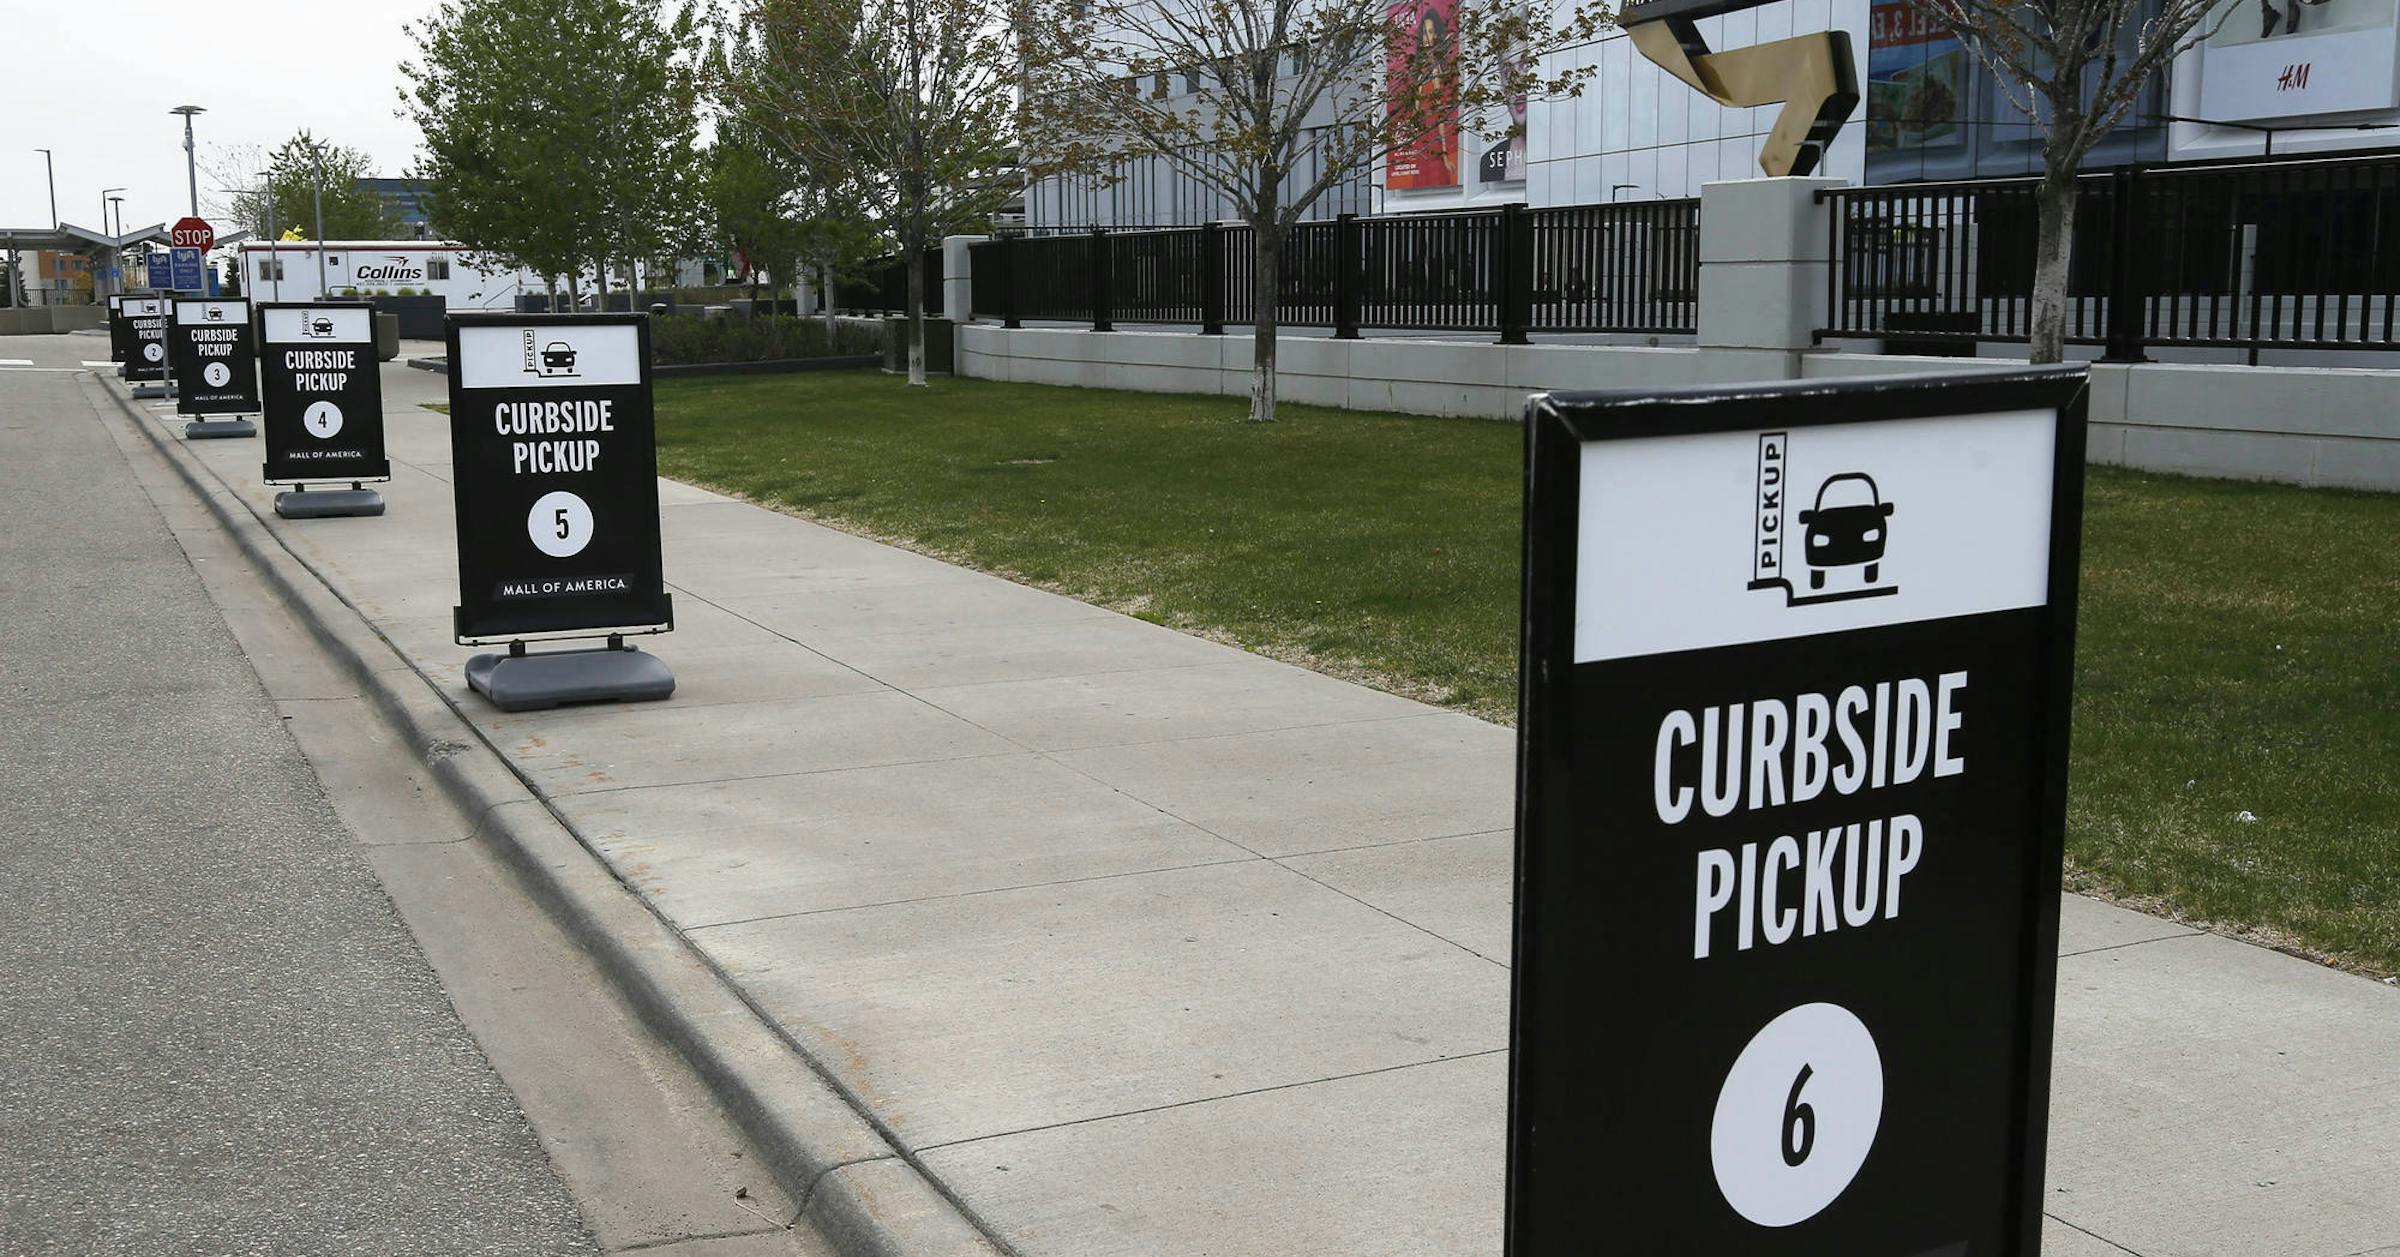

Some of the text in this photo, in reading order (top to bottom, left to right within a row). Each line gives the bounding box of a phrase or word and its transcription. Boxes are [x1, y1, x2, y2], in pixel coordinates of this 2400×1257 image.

[2277, 63, 2310, 91] H&M
[174, 229, 211, 245] STOP
[357, 265, 422, 279] Collins
[190, 329, 239, 342] CURBSIDE
[152, 347, 157, 357] 2
[198, 343, 233, 356] PICKUP
[526, 332, 534, 367] PICKUP
[285, 350, 356, 370] CURBSIDE
[214, 368, 221, 380] 3
[295, 372, 347, 391] PICKUP
[318, 411, 327, 428] 4
[495, 400, 614, 435] CURBSIDE
[325, 450, 362, 458] AMERICA
[513, 440, 600, 474] PICKUP
[1761, 443, 1781, 568] PICKUP
[555, 509, 569, 539] 5
[503, 578, 625, 596] MALL OF AMERICA
[1654, 671, 1968, 824] CURBSIDE
[1694, 814, 1923, 959] PICKUP
[1782, 1063, 1814, 1167] 6
